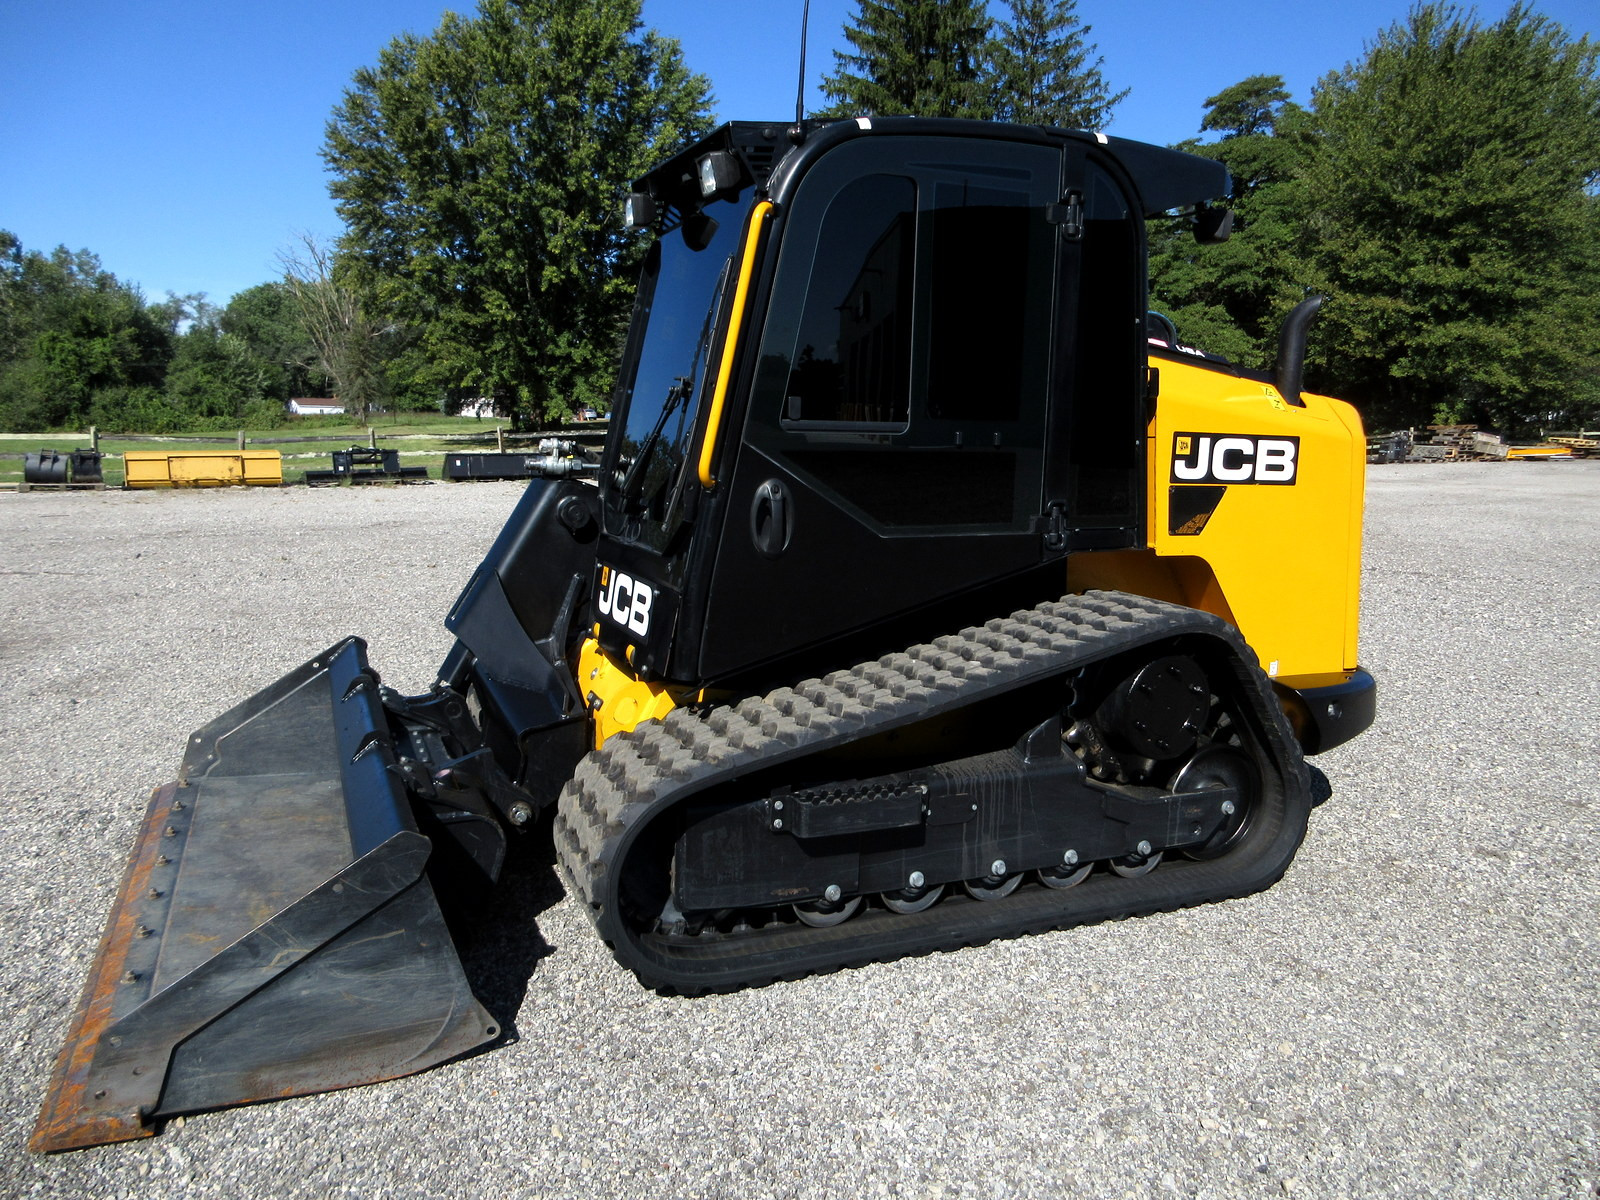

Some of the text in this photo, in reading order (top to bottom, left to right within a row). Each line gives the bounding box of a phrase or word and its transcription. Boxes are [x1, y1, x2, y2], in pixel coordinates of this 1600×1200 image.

[1175, 344, 1206, 357] USA
[1174, 437, 1296, 482] JCB
[599, 569, 652, 637] JCB
